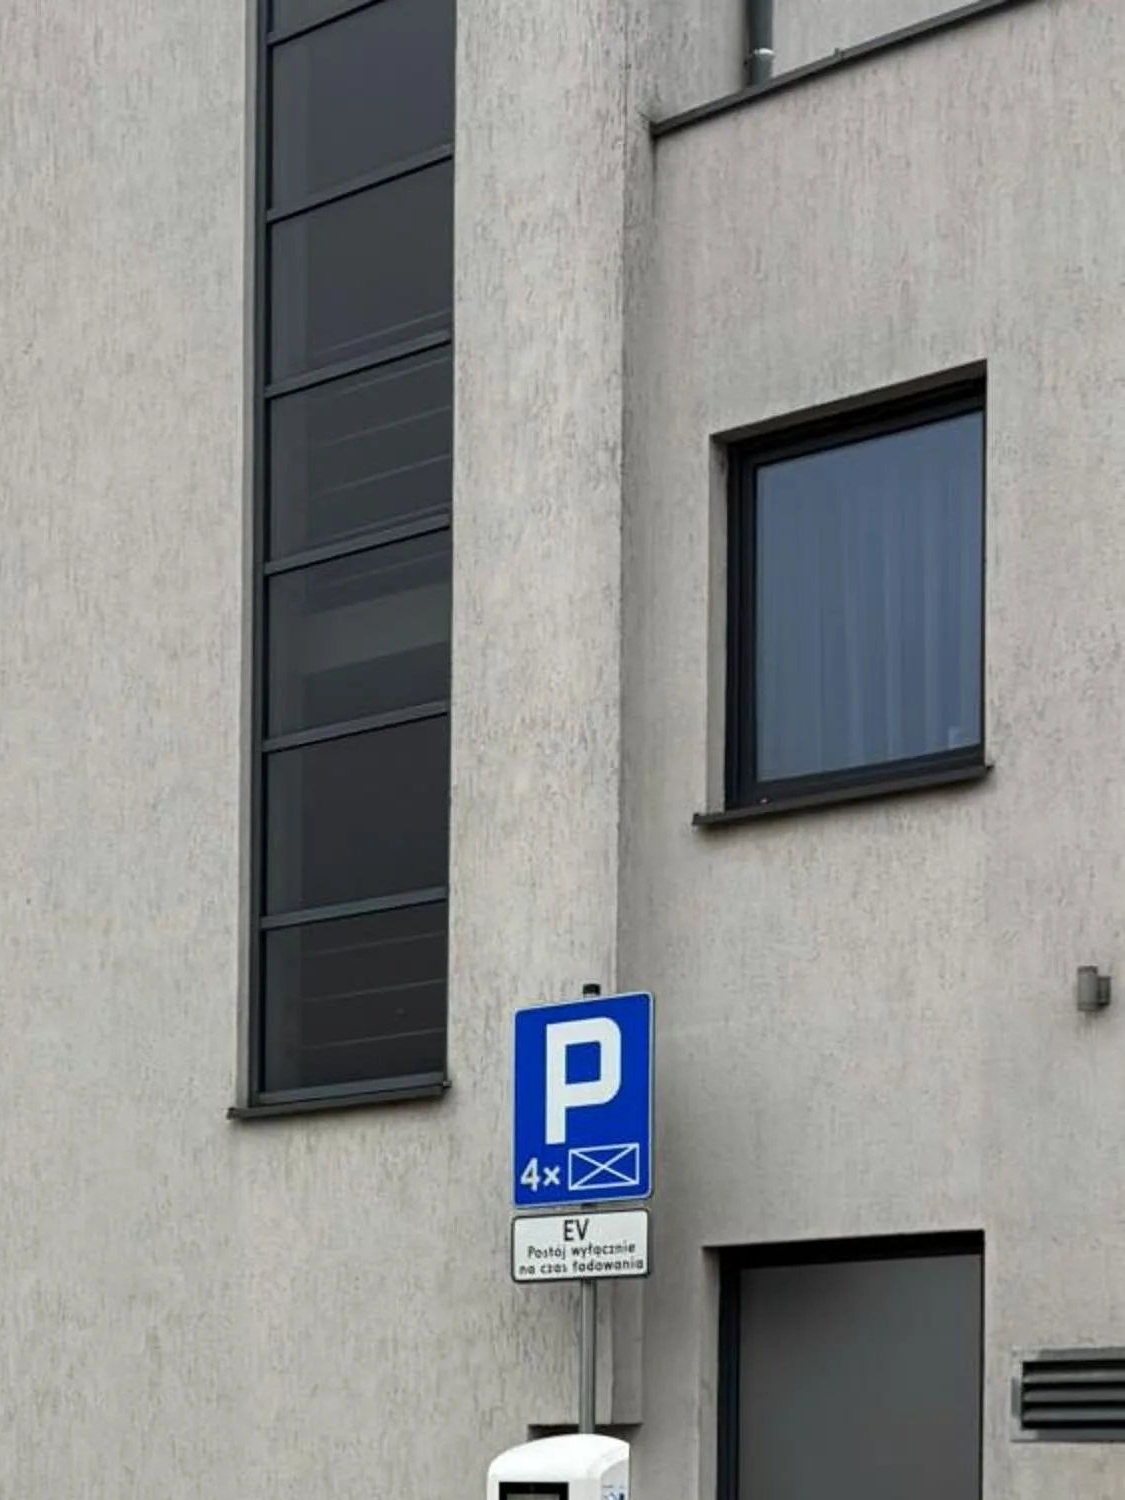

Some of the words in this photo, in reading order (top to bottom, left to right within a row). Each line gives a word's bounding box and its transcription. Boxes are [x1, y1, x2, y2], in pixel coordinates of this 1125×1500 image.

[546, 1017, 621, 1145] P
[564, 1219, 589, 1241] EV
[518, 1265, 535, 1275] na
[540, 1262, 567, 1274] czas
